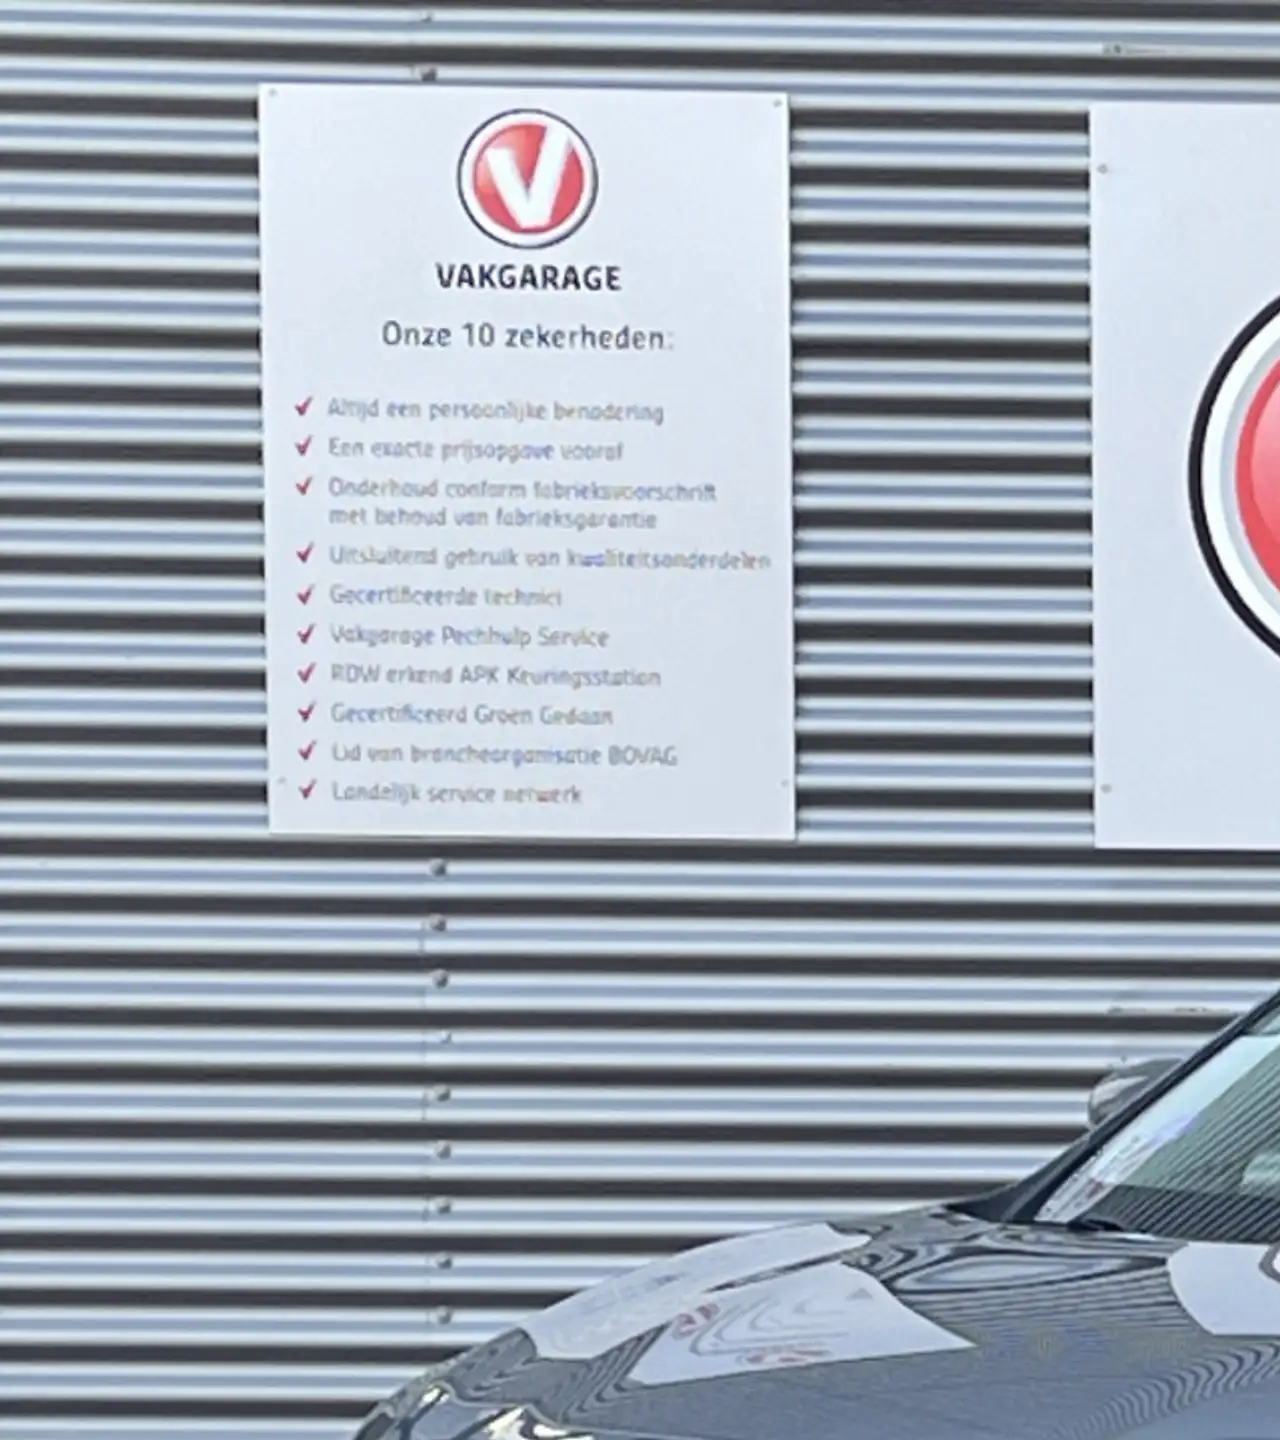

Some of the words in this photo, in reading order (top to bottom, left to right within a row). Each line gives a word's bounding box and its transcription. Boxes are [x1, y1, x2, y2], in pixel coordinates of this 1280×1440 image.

[436, 261, 622, 292] VAKGARAGE
[381, 319, 453, 349] Onze
[460, 319, 496, 349] 10
[326, 396, 380, 424] Altijd
[385, 400, 423, 421] een
[427, 399, 549, 425] persoonlijke
[327, 435, 366, 458] Een
[369, 439, 434, 460] exacte
[440, 438, 556, 466] prijsopgave
[559, 440, 625, 463] vooraf
[327, 475, 440, 499] Onderhoud
[444, 478, 528, 499] conform
[327, 507, 369, 527] met
[373, 506, 448, 528] behoud
[452, 510, 490, 528] van
[494, 506, 659, 534] fabrieksgarantie
[328, 543, 439, 567] Uitsluitend
[443, 546, 520, 571] gebruik
[523, 550, 561, 569] van
[565, 547, 773, 571] kwaliteitsonderdelen
[328, 622, 437, 649] Vakgarage
[440, 624, 533, 652] Pechhulp
[536, 625, 611, 649] Service
[329, 662, 381, 685] RDW
[385, 664, 454, 685] erkend
[458, 663, 501, 686] APK
[506, 664, 663, 692] Keuringsstation
[329, 700, 469, 726] Gecertificeerd
[472, 702, 534, 727] Groen
[538, 704, 615, 726] Gedaan
[330, 741, 363, 763] Lid
[366, 746, 405, 764] van
[409, 743, 603, 770] brancheorganisatie
[607, 743, 680, 767] BOVAG
[330, 780, 422, 808] Landelijk
[425, 785, 497, 805] service
[502, 783, 584, 805] netwerk
